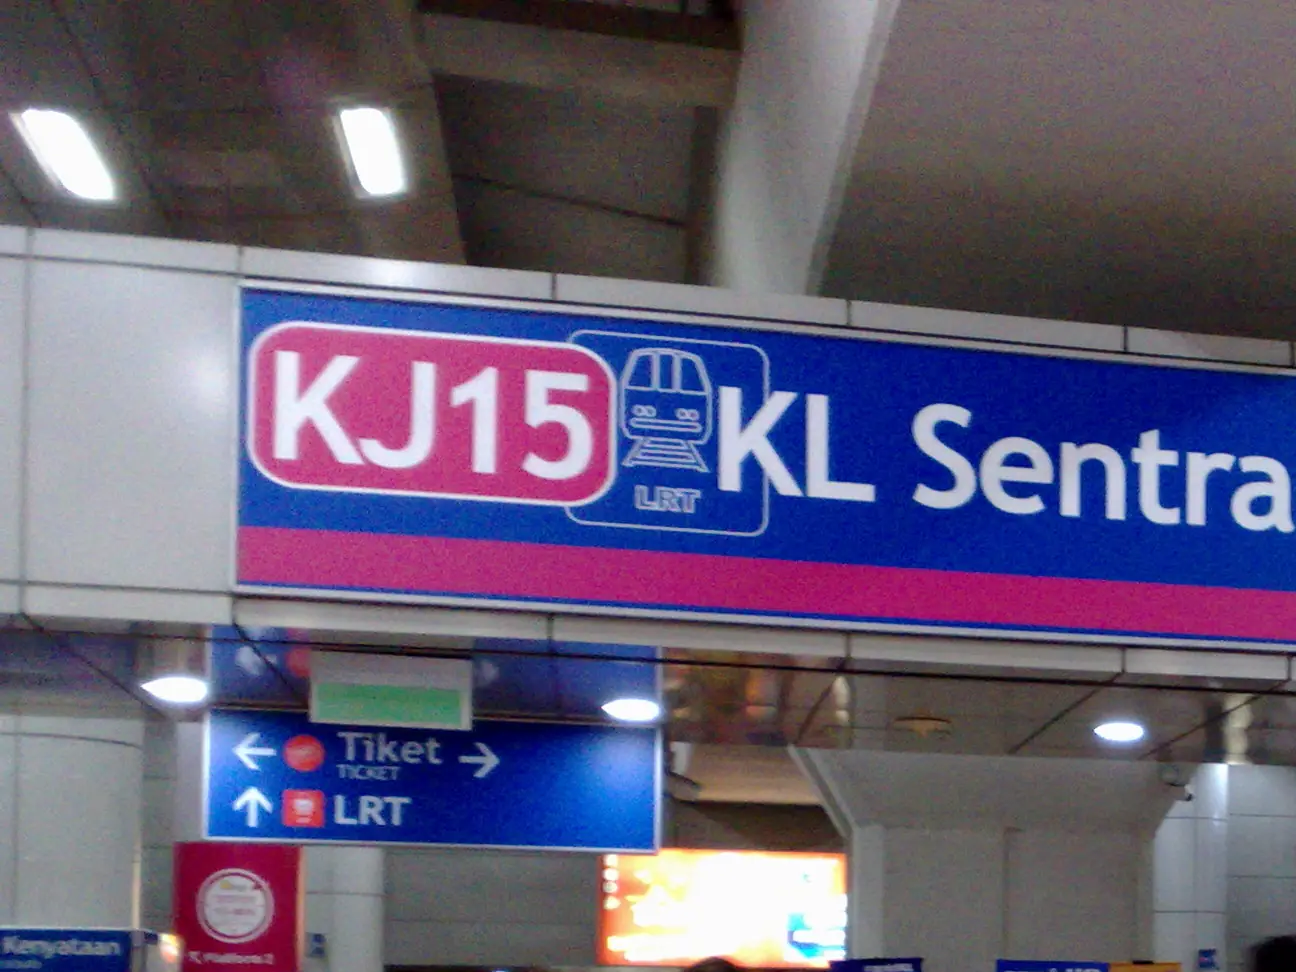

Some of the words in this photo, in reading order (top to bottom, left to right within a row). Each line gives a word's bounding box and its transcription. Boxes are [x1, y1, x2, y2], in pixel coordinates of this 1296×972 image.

[272, 350, 594, 481] KJ15
[717, 386, 876, 501] KL
[634, 485, 702, 513] LRT
[336, 731, 443, 765] Tiket
[336, 763, 401, 781] TICKET
[334, 794, 412, 826] LRT
